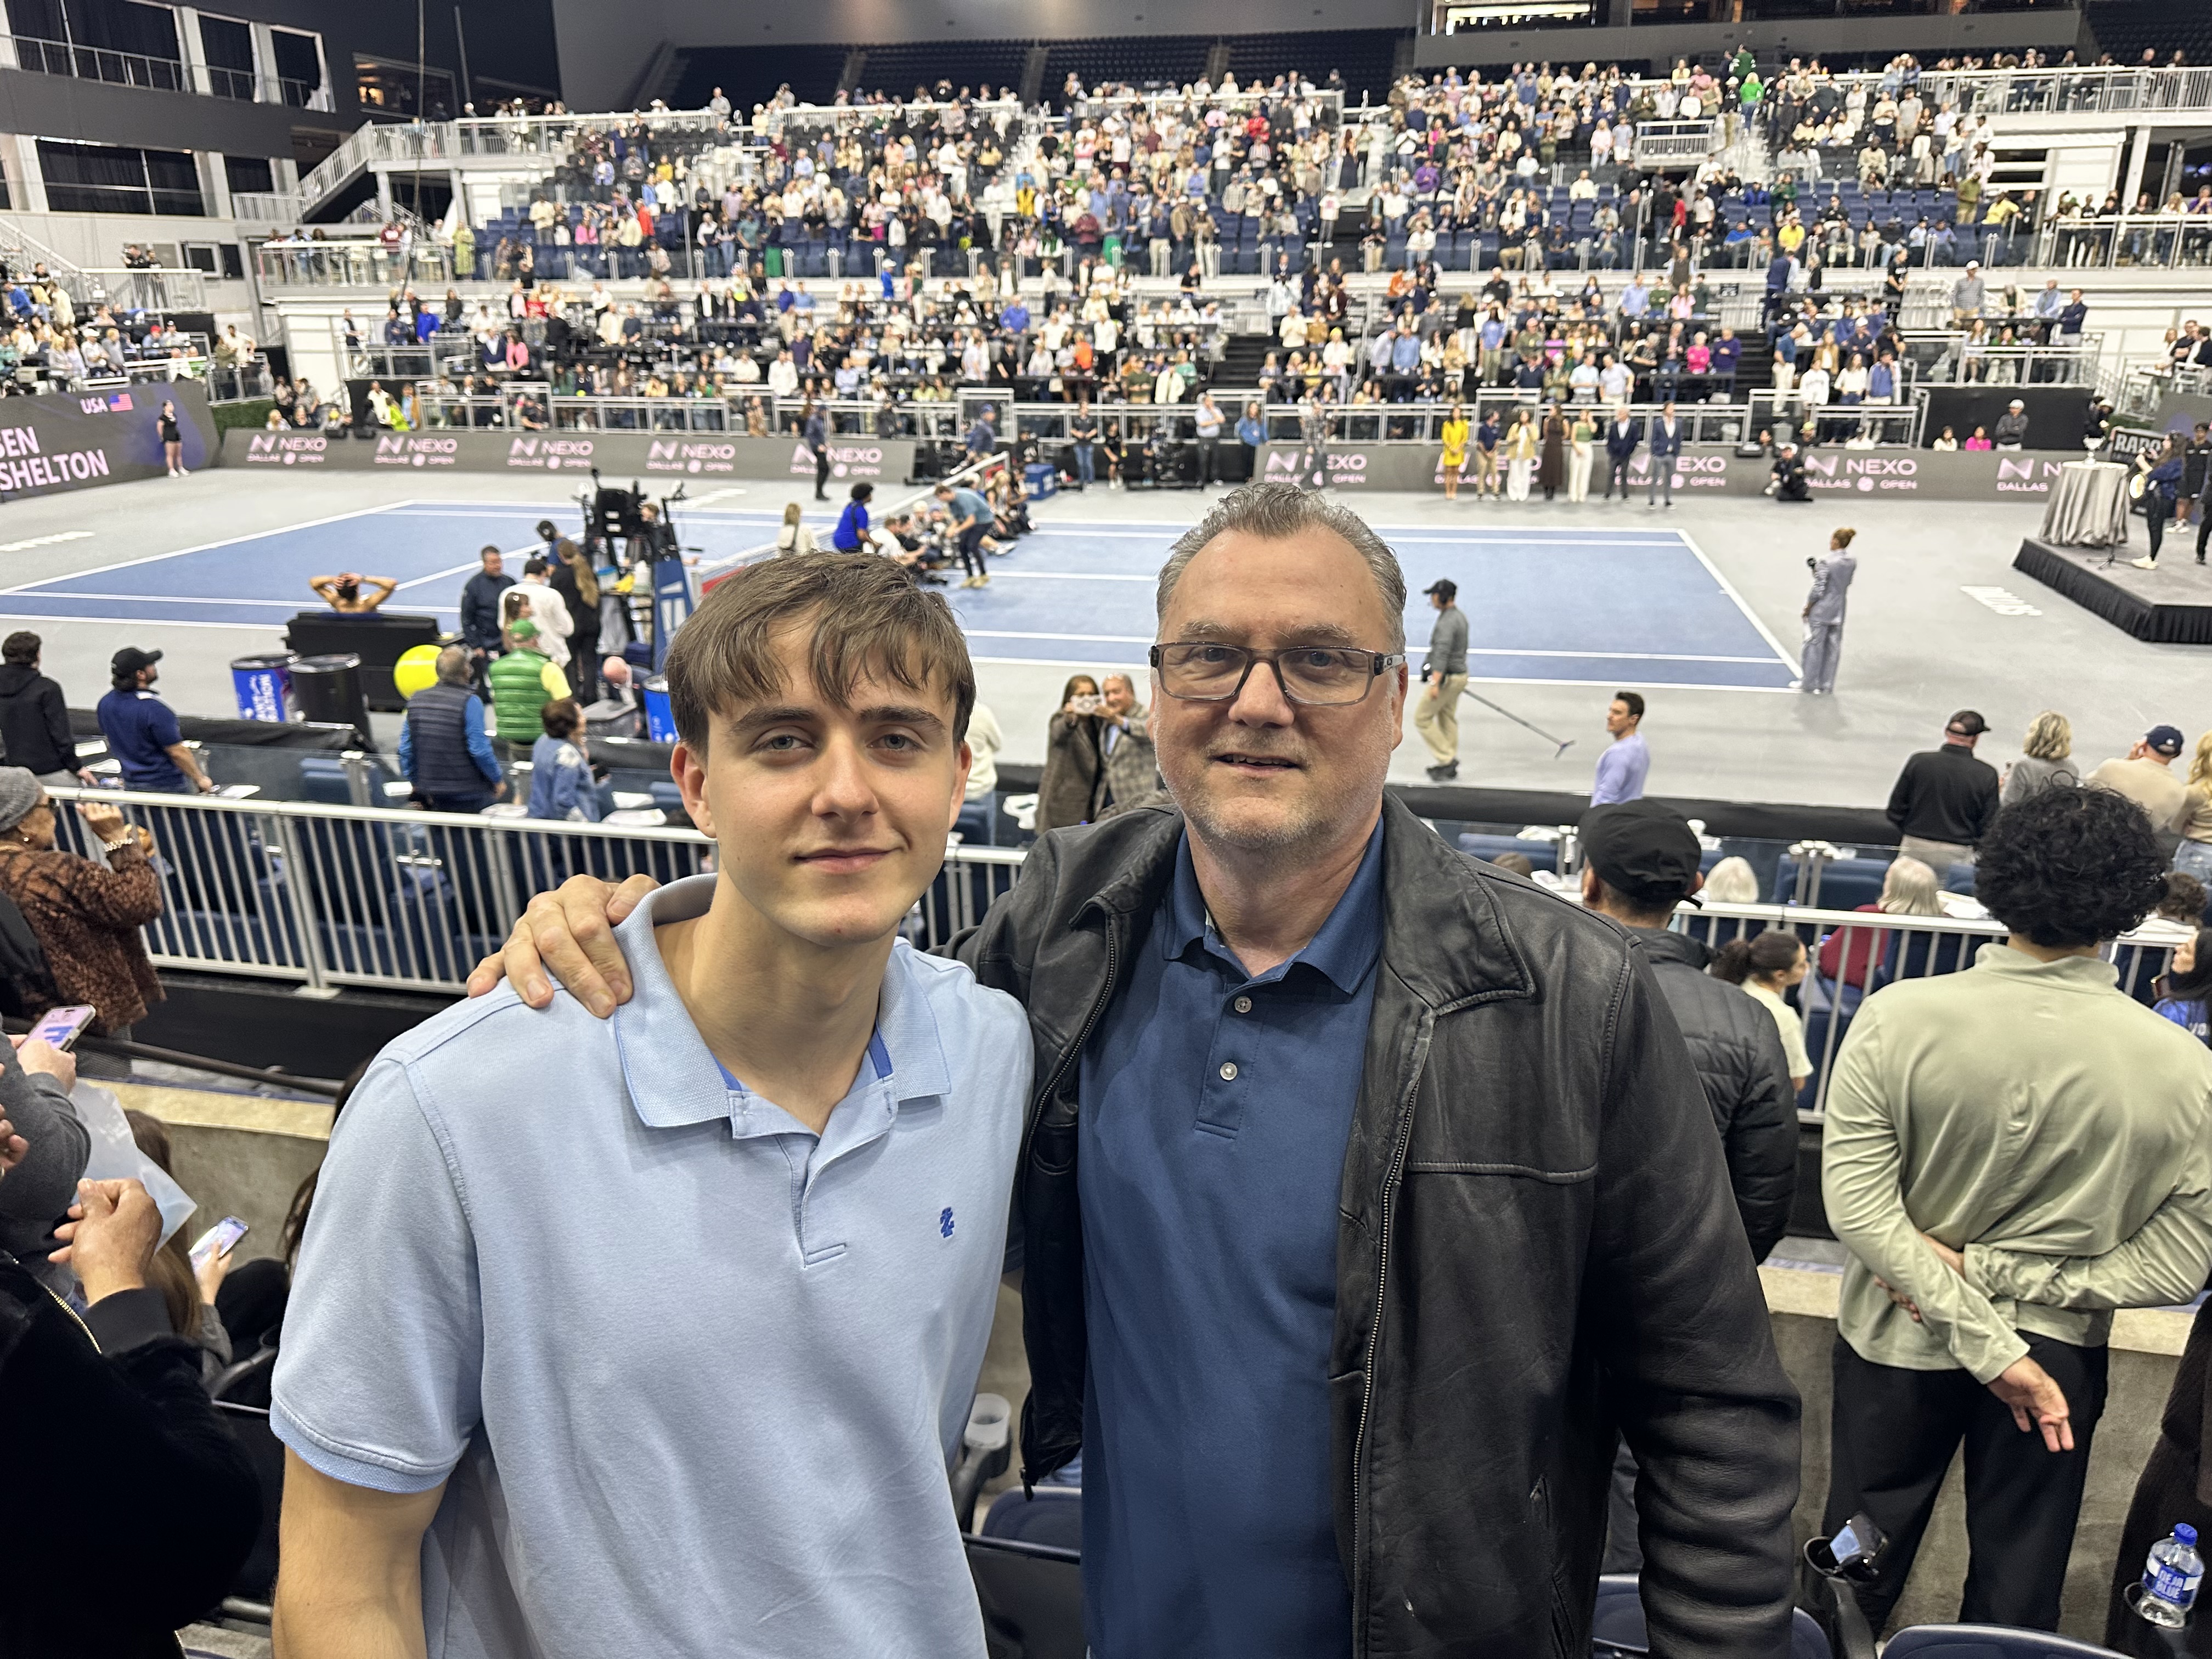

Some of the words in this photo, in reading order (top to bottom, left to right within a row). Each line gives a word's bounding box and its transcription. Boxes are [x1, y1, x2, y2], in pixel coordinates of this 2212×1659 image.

[80, 397, 108, 414] USA
[278, 437, 327, 452] NEXO
[407, 438, 458, 453] NEXO
[541, 440, 594, 456] NEXO
[681, 443, 736, 459] NEXO
[826, 447, 882, 463] NEXO
[0, 449, 109, 490] SHELTON
[1676, 456, 1726, 472] EXO
[1846, 459, 1917, 476] NEXO
[1997, 482, 2048, 492] DALLAS
